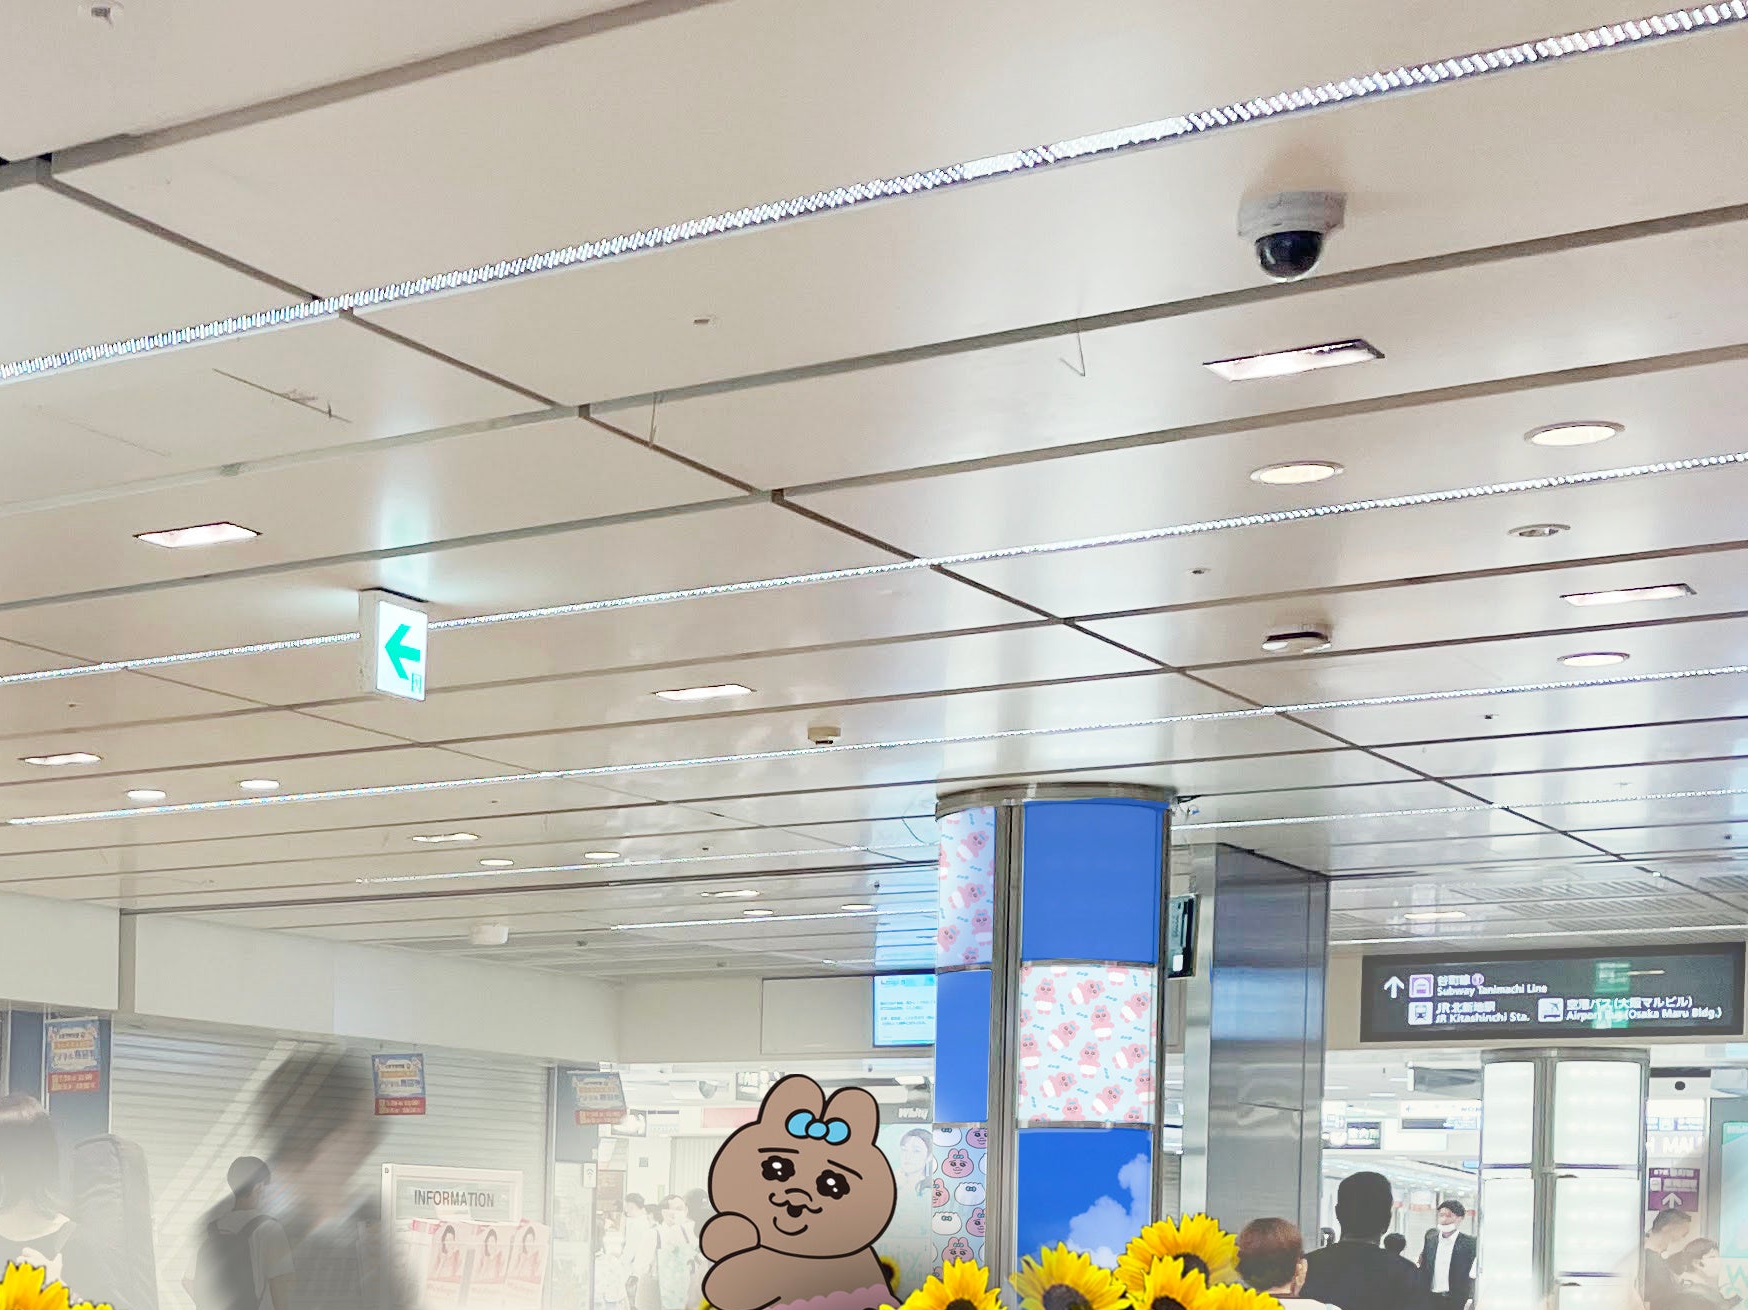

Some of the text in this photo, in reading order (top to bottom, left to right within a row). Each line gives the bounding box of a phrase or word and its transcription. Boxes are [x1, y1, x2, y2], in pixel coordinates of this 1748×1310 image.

[1437, 983, 1548, 997] Subway Tanimachi Line
[1509, 1011, 1531, 1022] Sta.
[414, 1189, 495, 1208] INFORMATION
